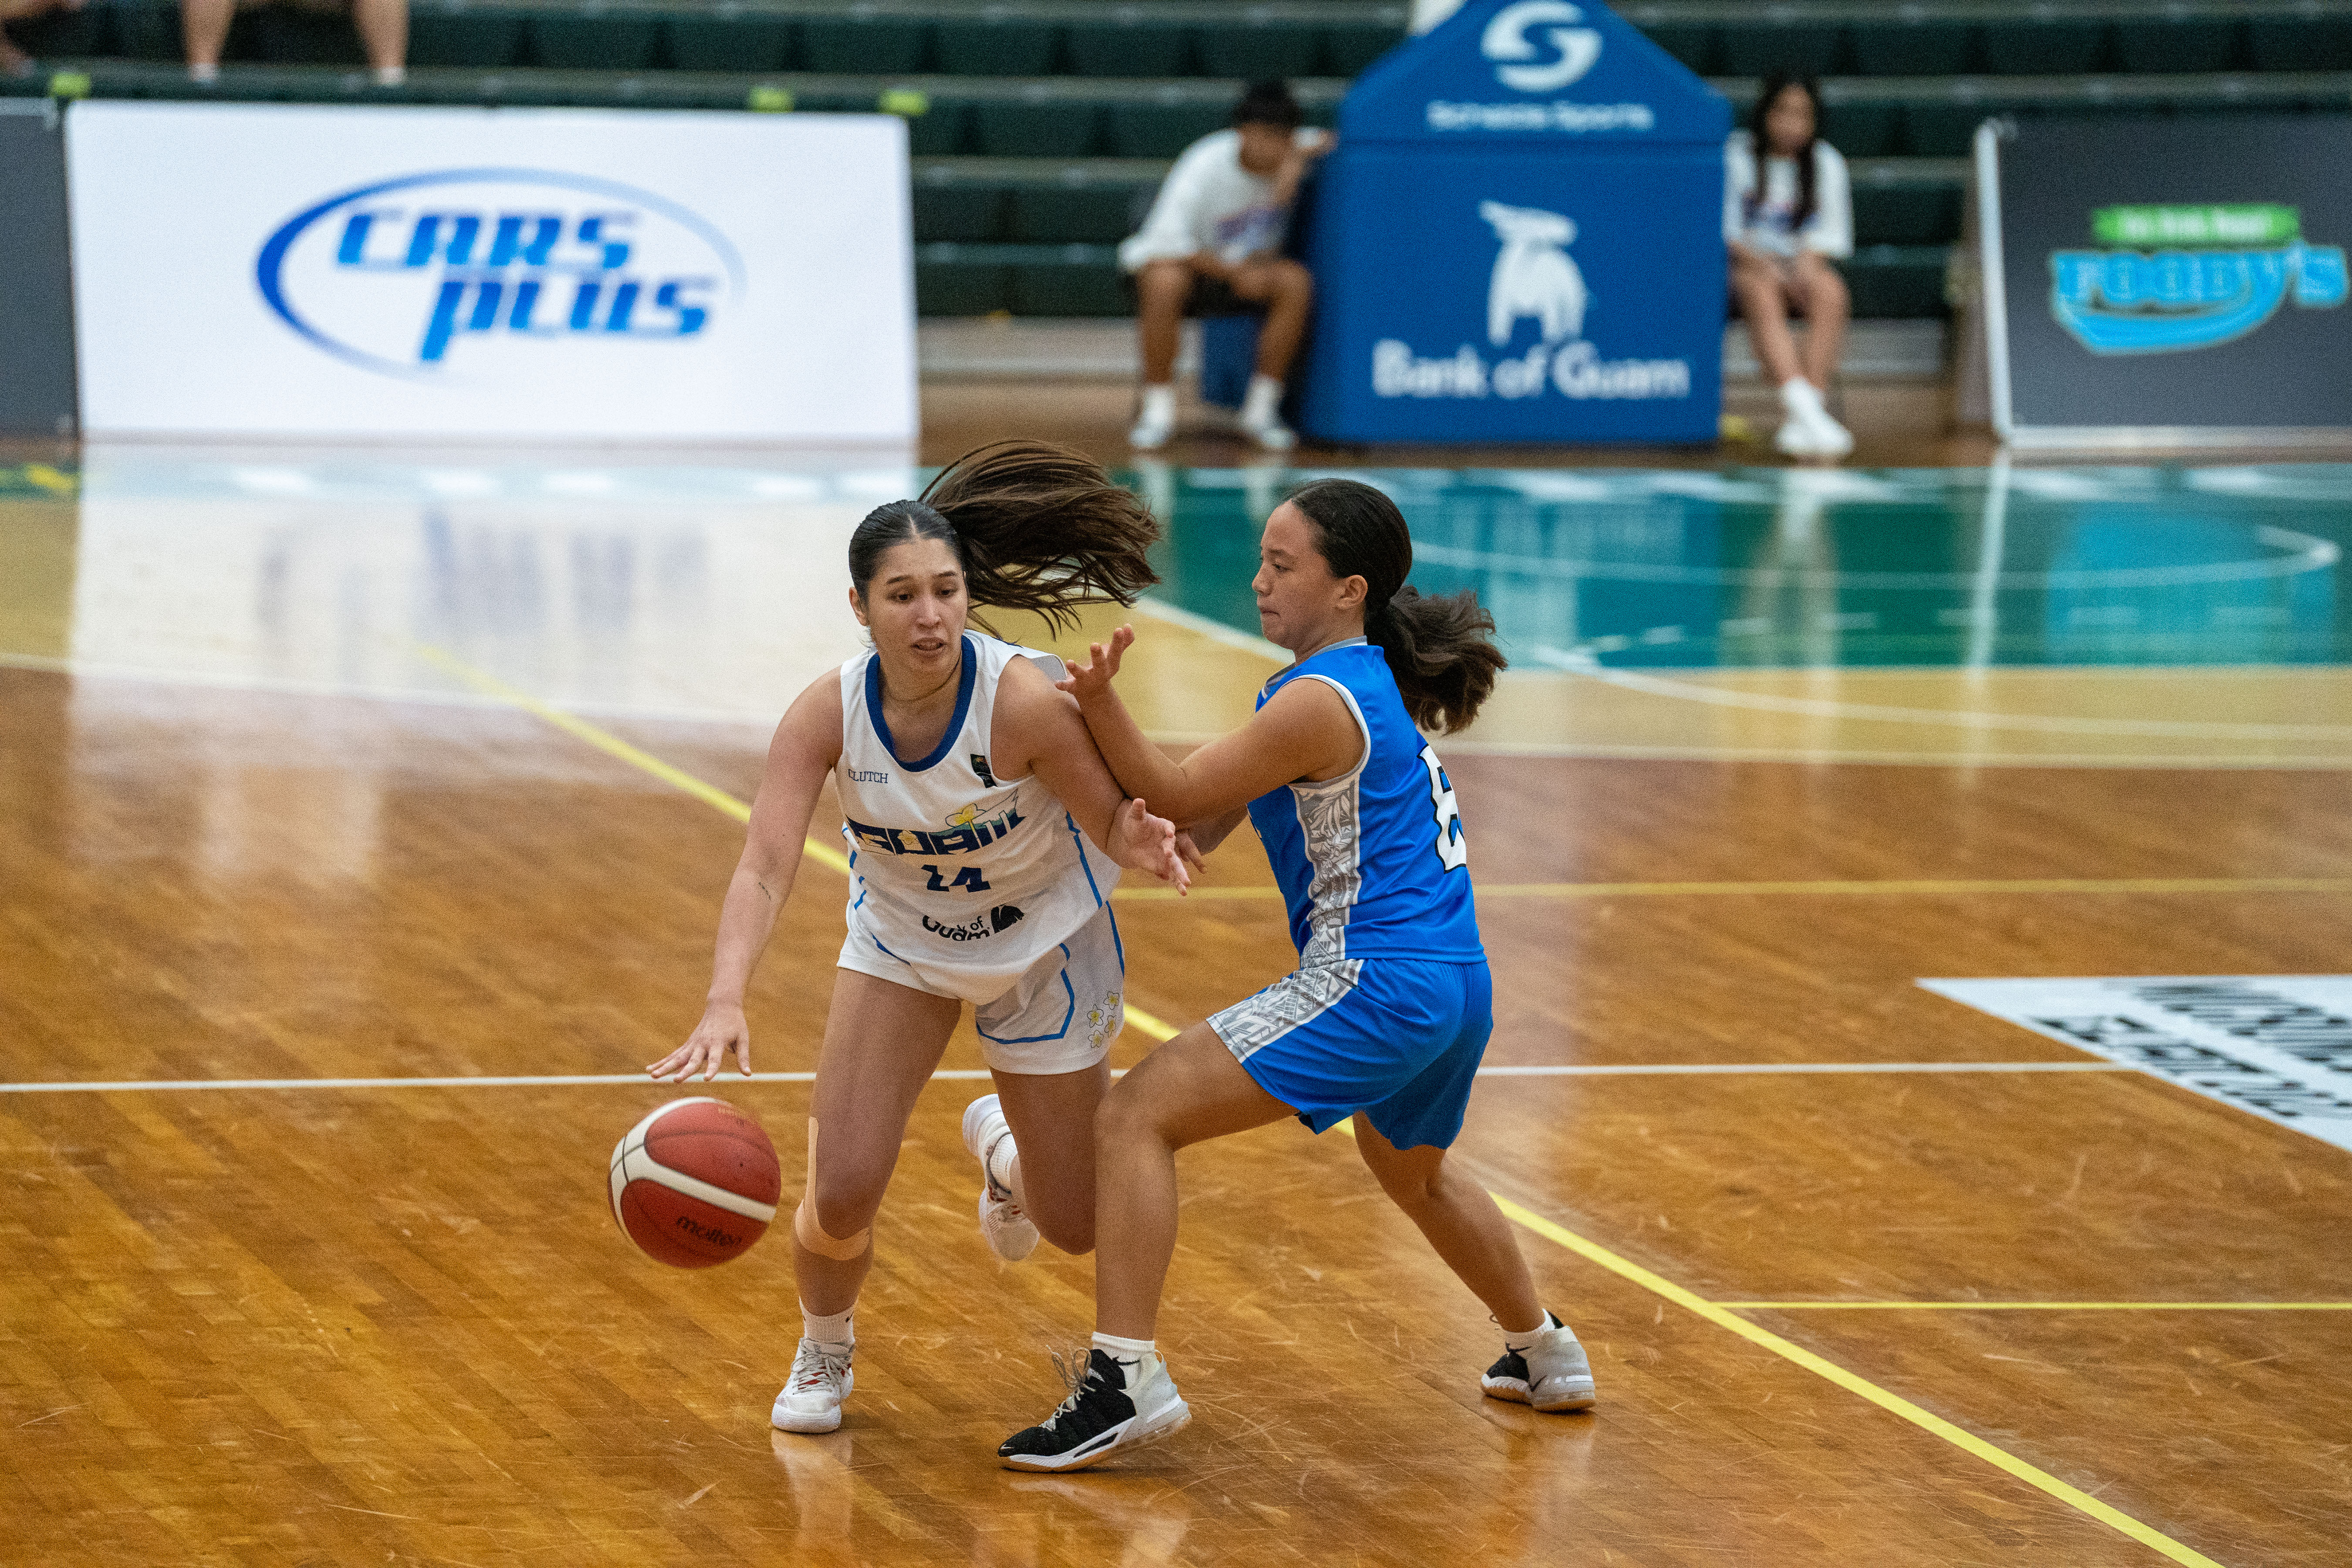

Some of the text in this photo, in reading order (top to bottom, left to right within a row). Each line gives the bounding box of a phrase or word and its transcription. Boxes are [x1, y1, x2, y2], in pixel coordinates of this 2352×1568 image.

[335, 210, 637, 271] CARS
[1374, 341, 1690, 398] Bank of Guam
[848, 768, 889, 784] CLUTCH
[921, 864, 992, 893] 14
[970, 916, 984, 931] of
